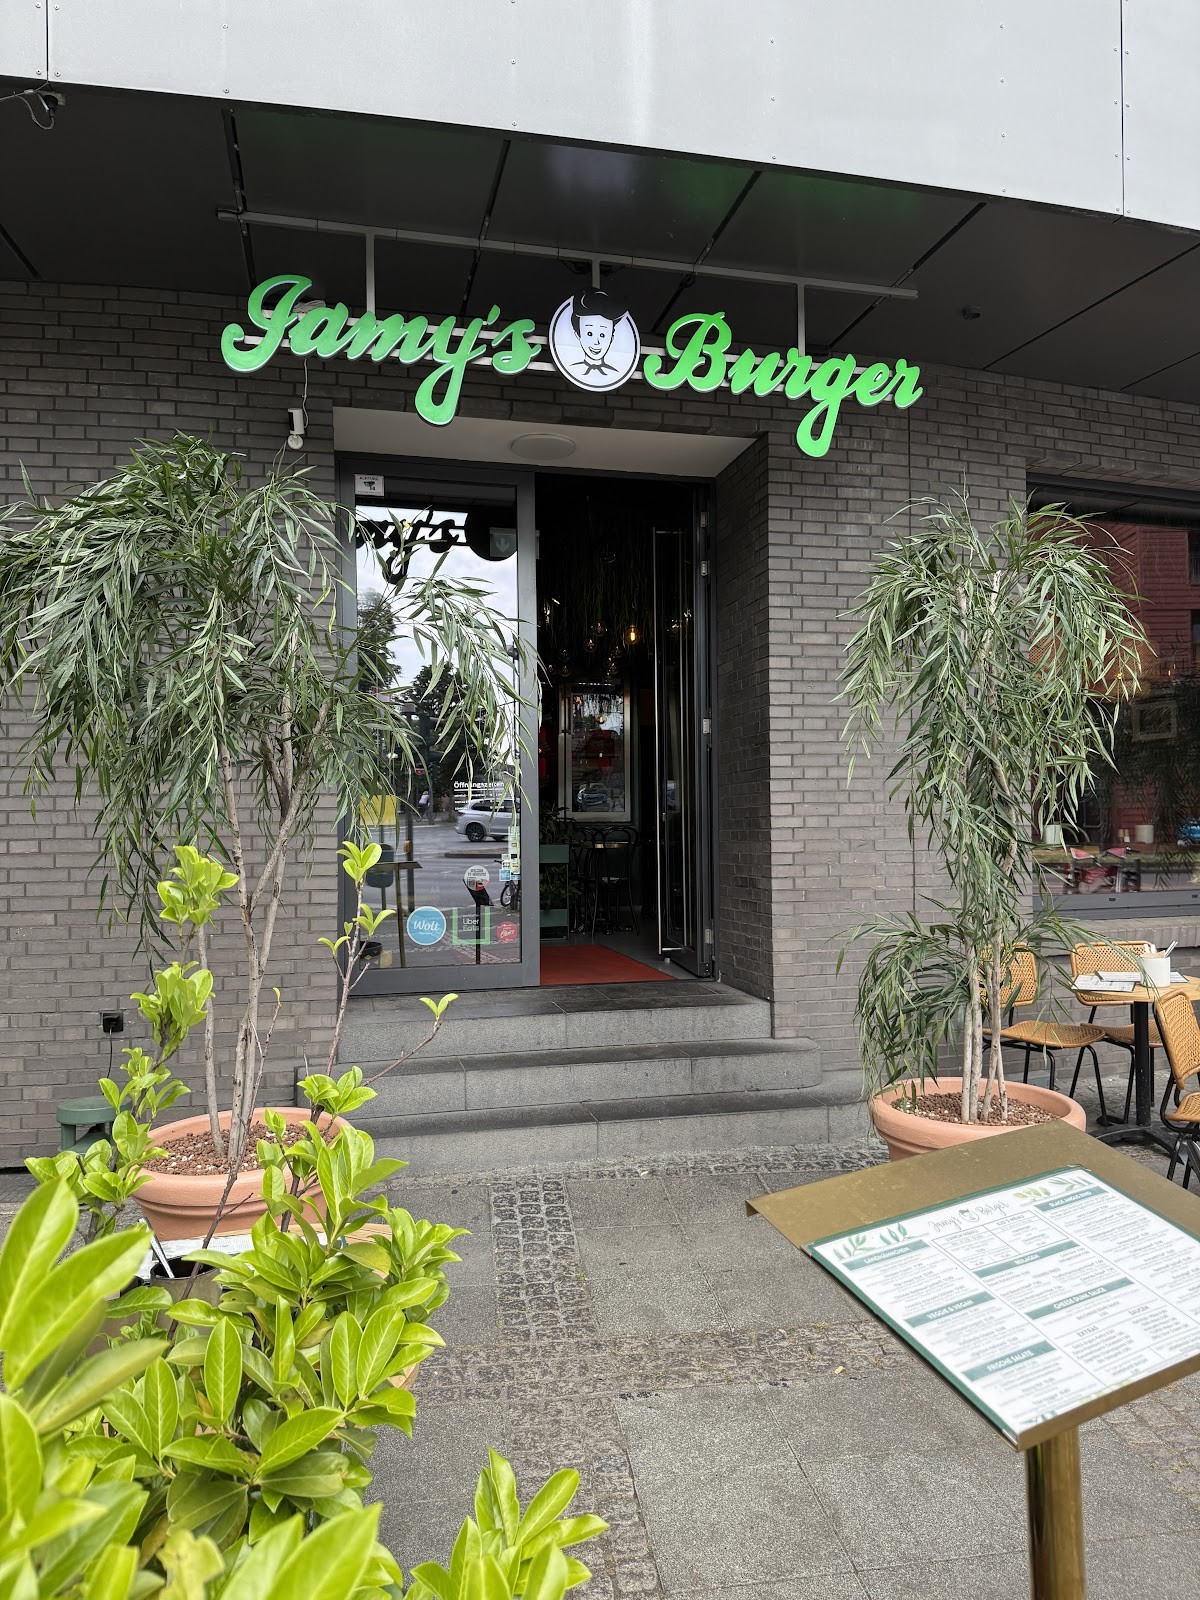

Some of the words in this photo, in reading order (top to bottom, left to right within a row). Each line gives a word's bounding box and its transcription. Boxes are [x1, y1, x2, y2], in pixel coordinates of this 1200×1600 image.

[221, 274, 543, 426] Jamy's
[643, 311, 924, 458] Burger
[413, 920, 440, 931] Wolt
[1052, 1298, 1074, 1309] CHEESE
[1087, 1286, 1107, 1296] SAUCE
[926, 1307, 949, 1319] VEGGIE
[952, 1299, 974, 1309] VEGAN
[1076, 1325, 1099, 1337] EXTRAS
[986, 1357, 1013, 1371] FRISCHE
[1010, 1349, 1035, 1362] SALATE
